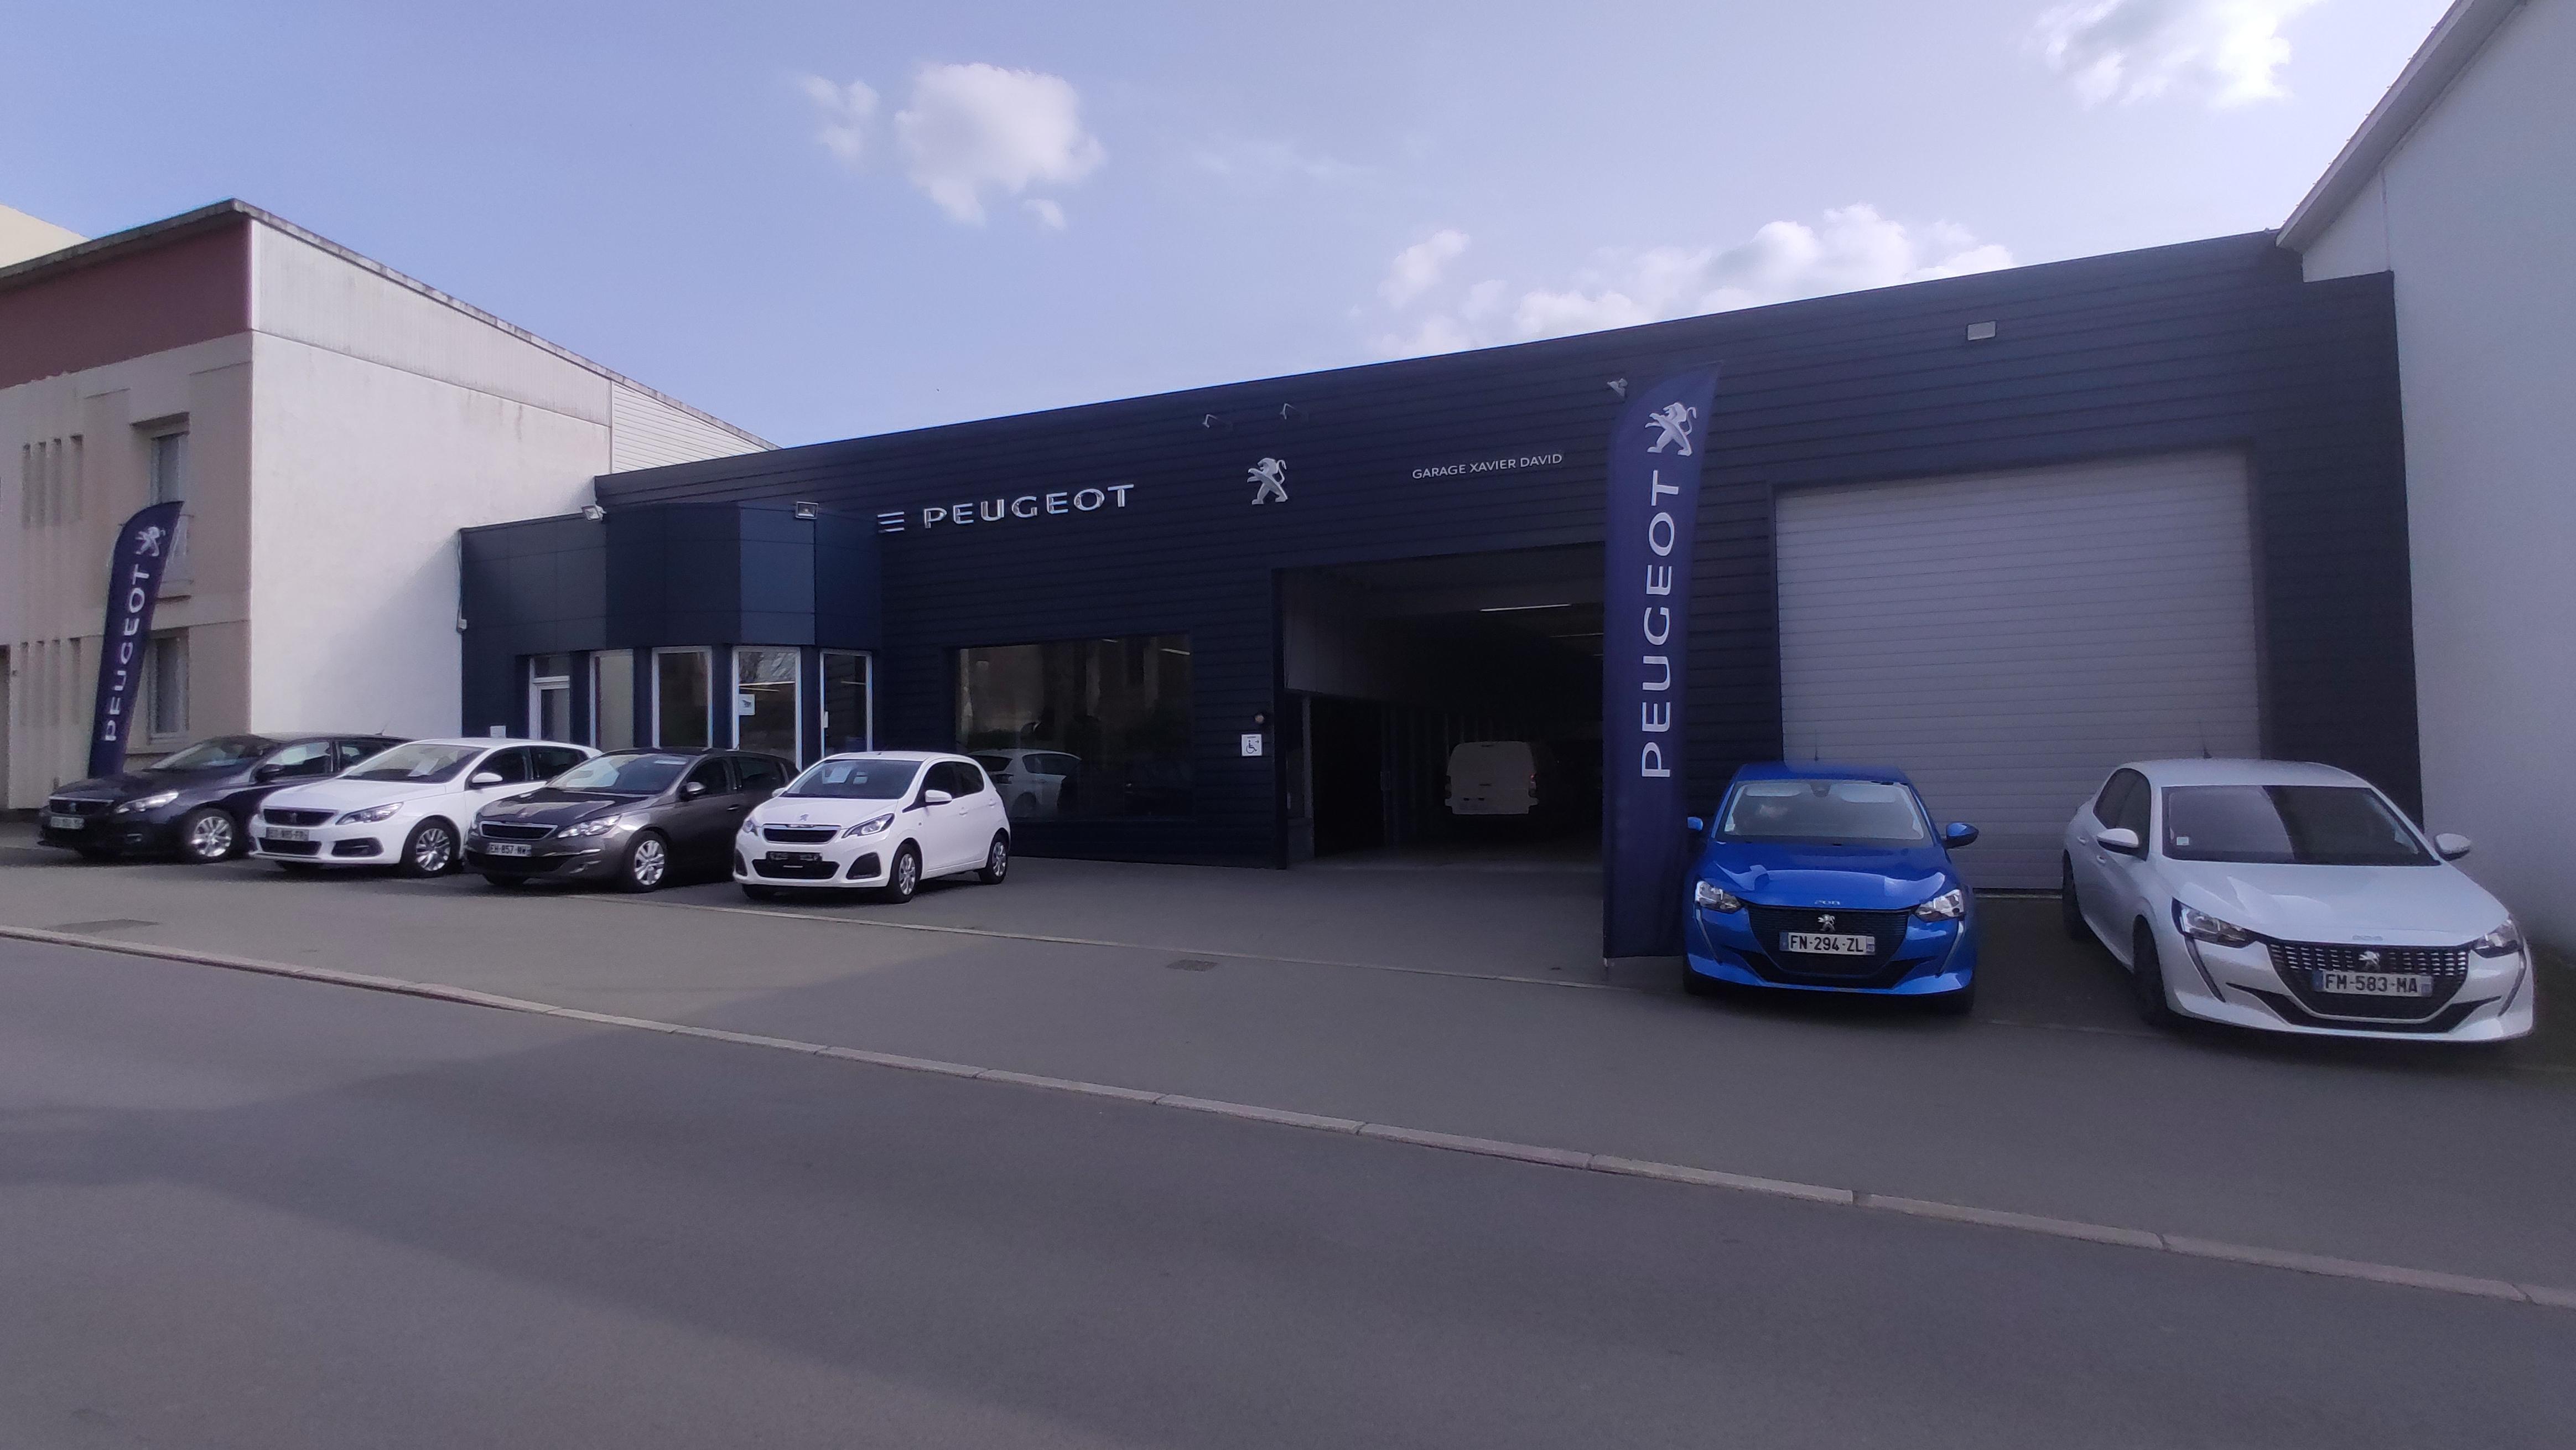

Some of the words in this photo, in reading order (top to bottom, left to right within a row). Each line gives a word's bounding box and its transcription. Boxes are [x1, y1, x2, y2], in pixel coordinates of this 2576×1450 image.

[1412, 464, 1466, 479] GARAGE
[1469, 459, 1516, 473] XAVIER
[1520, 453, 1562, 468] DAVID
[923, 484, 1135, 529] PEUGEOT
[1641, 469, 1679, 778] PEUGEOT
[1790, 935, 1864, 952] FN-294-ZL
[2325, 973, 2418, 993] FM-583-MA
